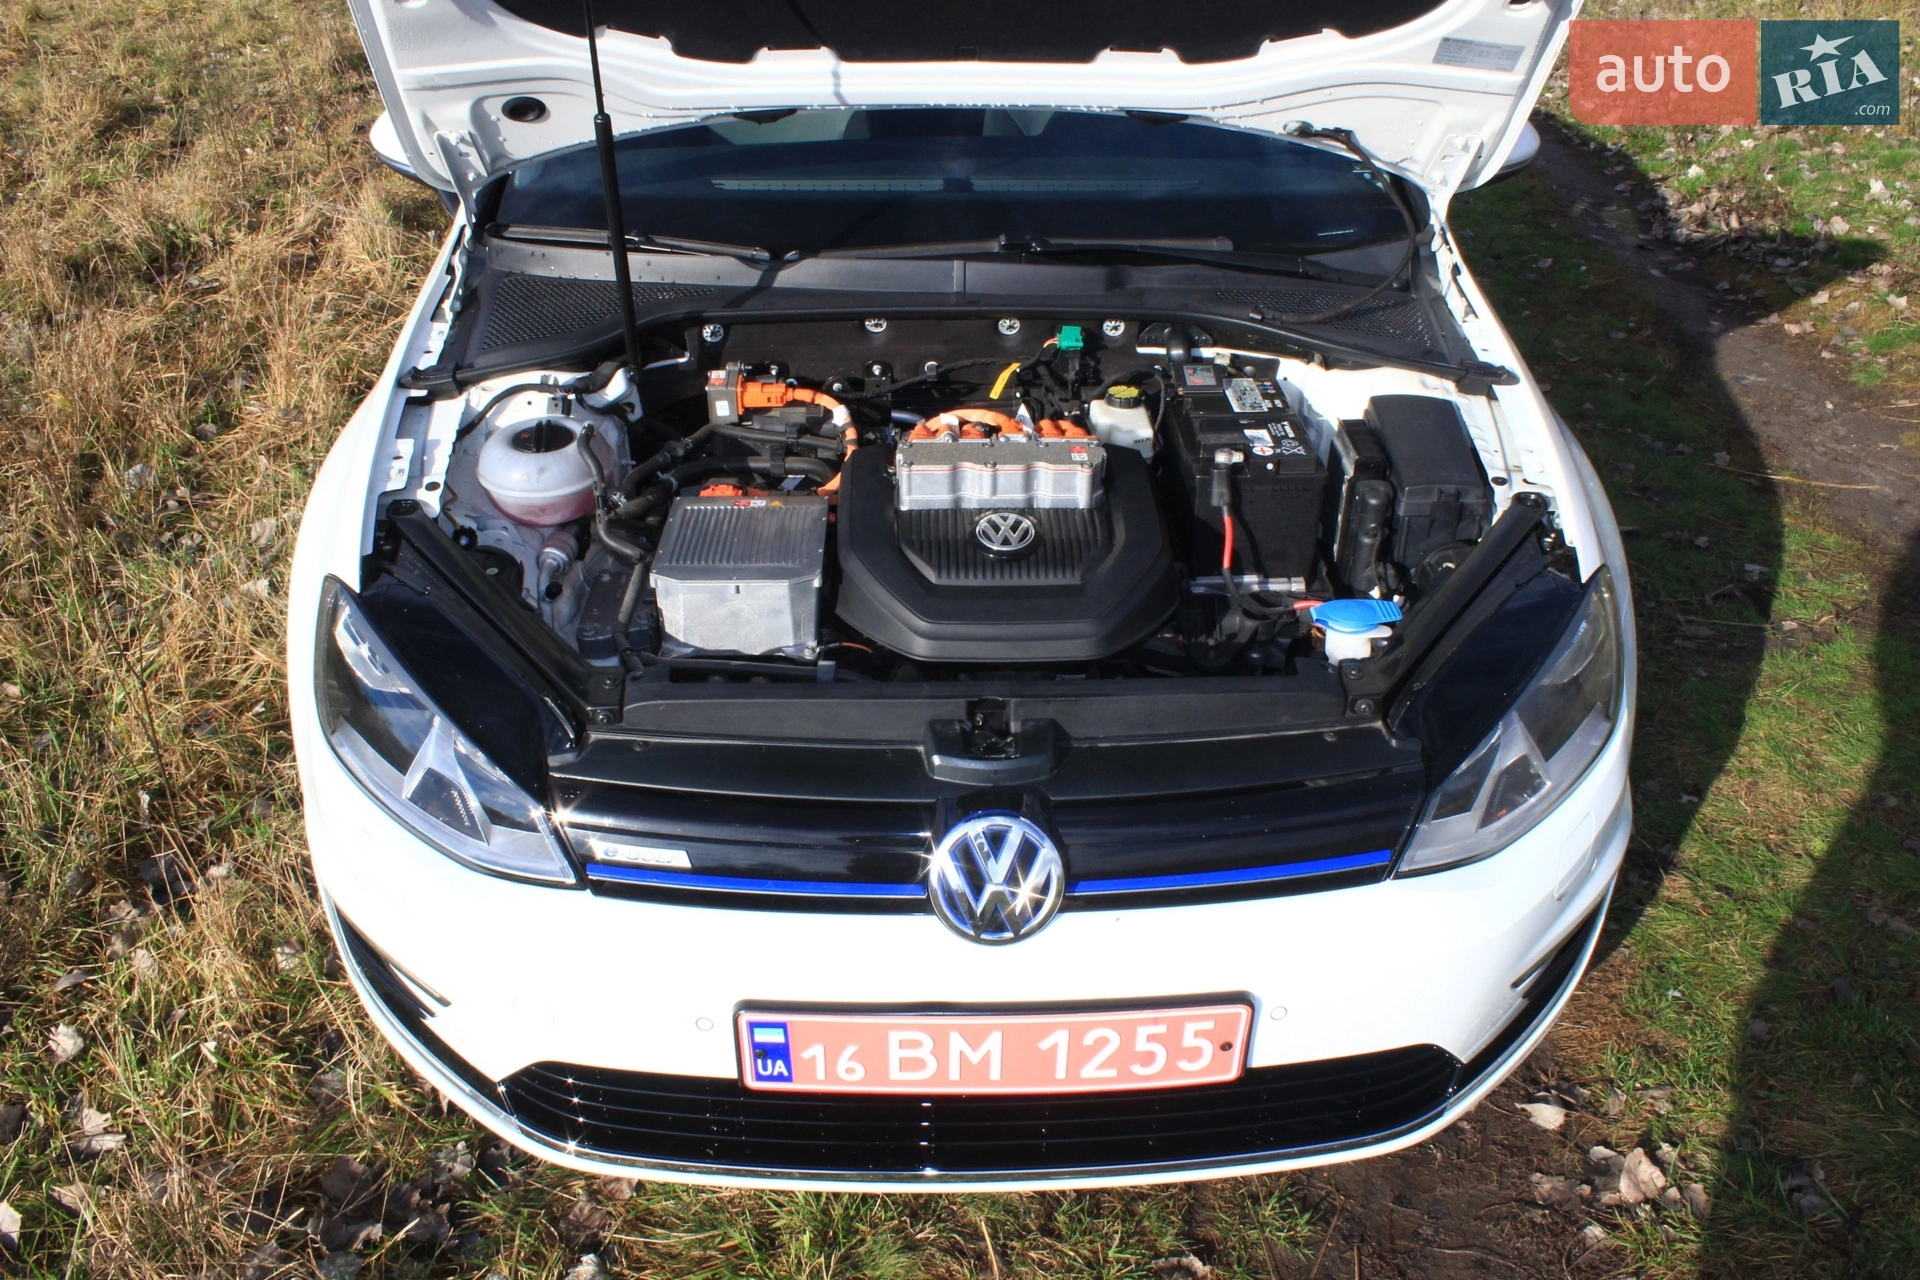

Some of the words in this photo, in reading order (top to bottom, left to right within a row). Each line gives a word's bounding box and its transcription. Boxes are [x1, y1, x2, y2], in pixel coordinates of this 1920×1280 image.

[756, 1060, 789, 1077] UA
[800, 1044, 866, 1081] 16
[888, 1030, 1000, 1080] BM
[1037, 1021, 1215, 1079] 1255
